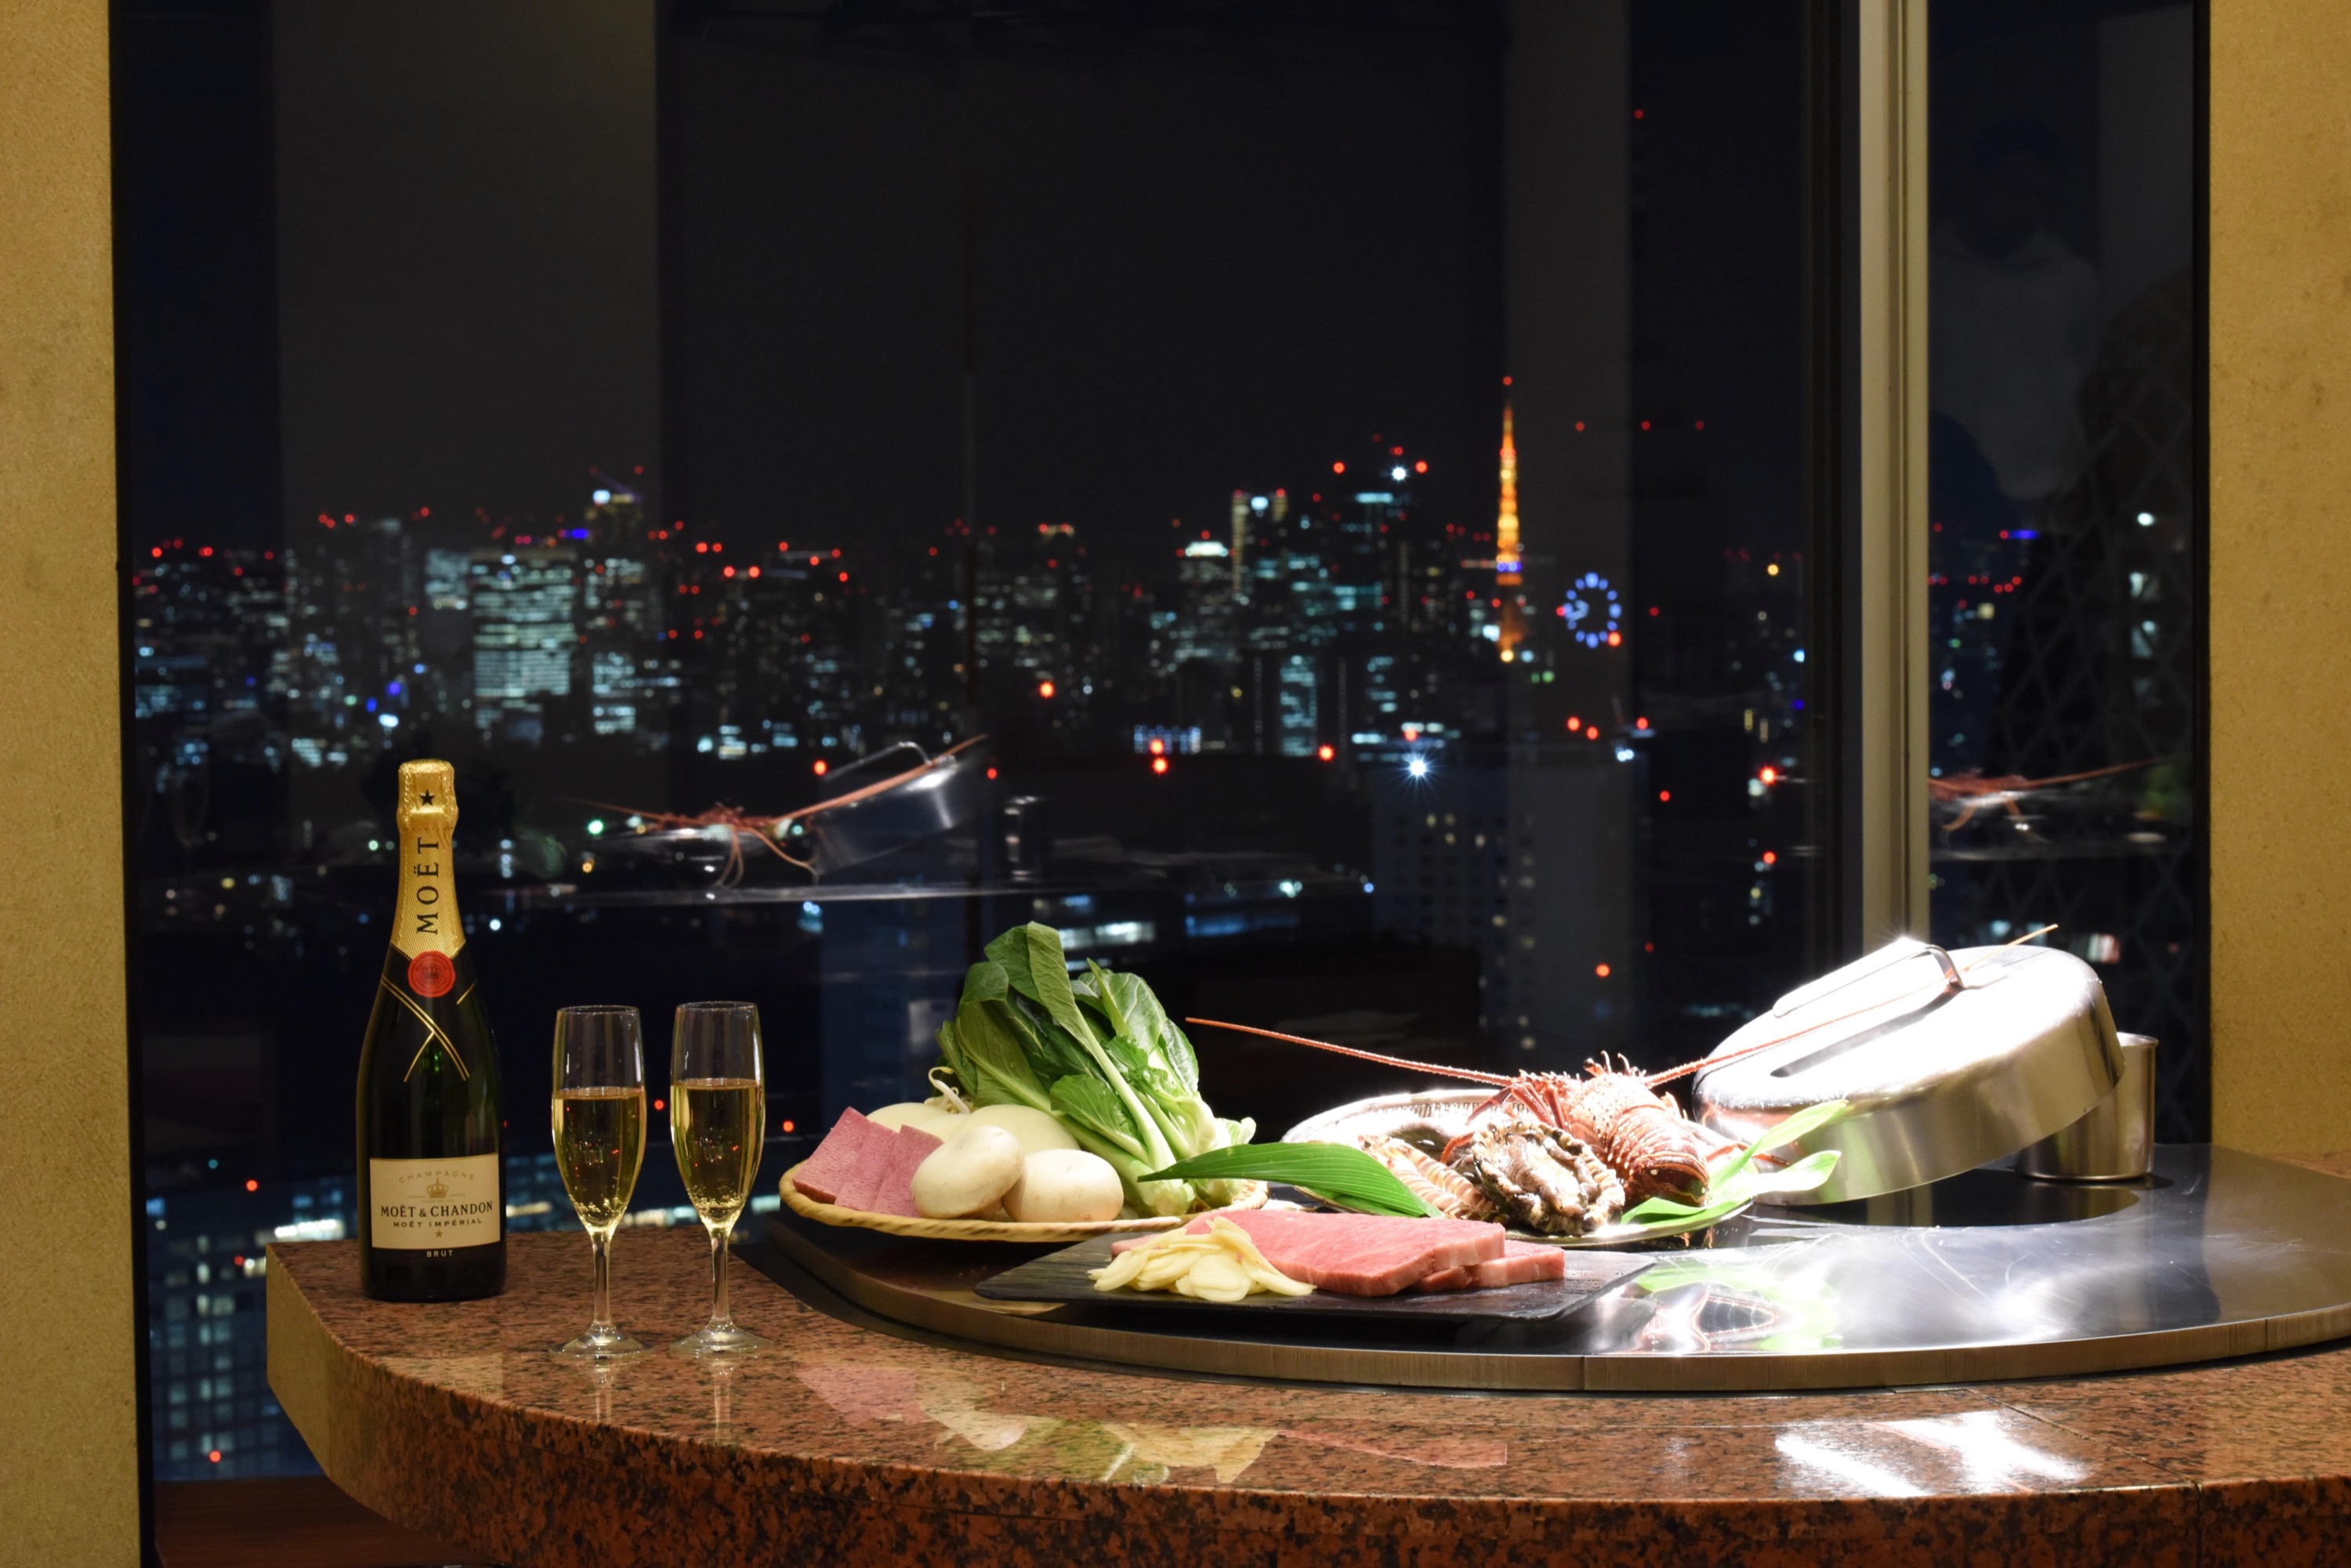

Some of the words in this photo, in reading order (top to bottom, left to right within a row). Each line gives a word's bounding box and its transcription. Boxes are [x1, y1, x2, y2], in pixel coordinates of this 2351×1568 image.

[414, 837, 439, 935] MOËT
[399, 1170, 475, 1183] CHAMPAGNE
[381, 1204, 416, 1218] MOËT
[418, 1208, 427, 1218] &
[430, 1200, 493, 1217] CHANDON
[429, 1218, 482, 1228] IMPÉRIAL
